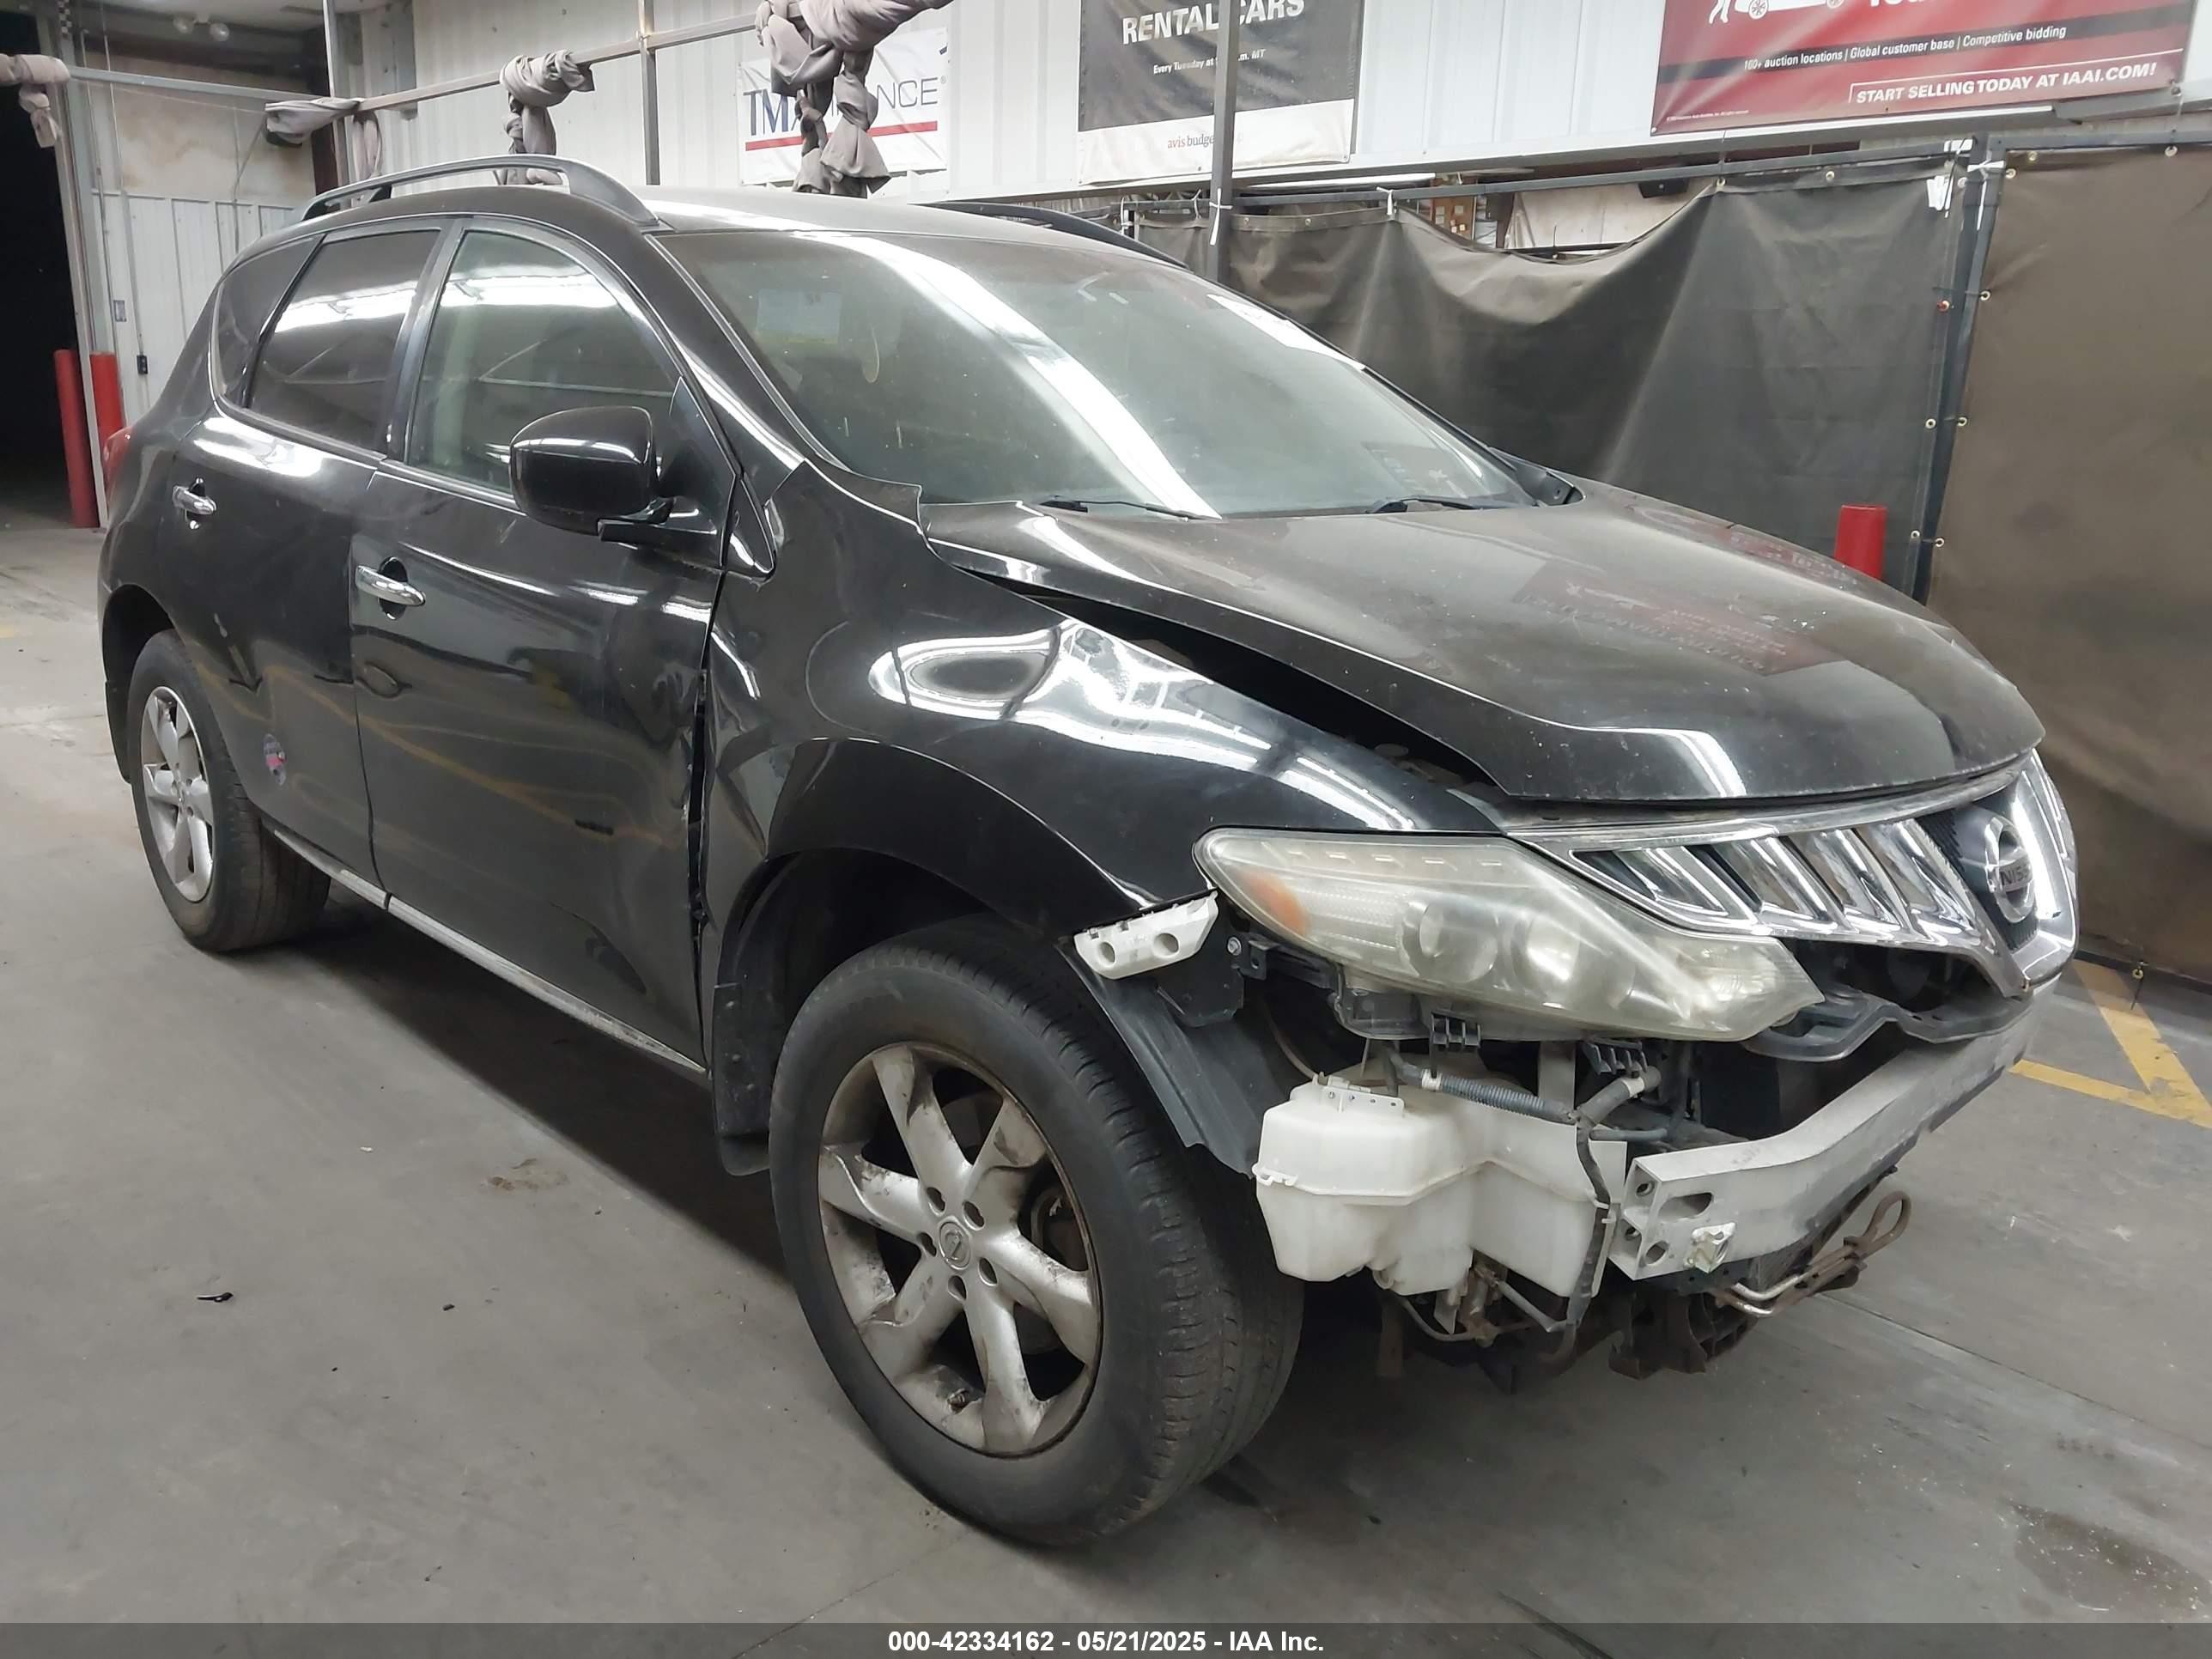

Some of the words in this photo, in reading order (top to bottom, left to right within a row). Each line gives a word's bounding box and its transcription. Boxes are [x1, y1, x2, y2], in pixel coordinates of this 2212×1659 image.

[1122, 3, 1219, 44] RENTAL
[1764, 53, 1798, 69] auction
[1801, 50, 1843, 65] locations
[1850, 44, 1881, 59] Global
[1881, 40, 1929, 56] customer
[1930, 38, 1955, 52] base
[1963, 29, 2023, 47] Competitive
[2026, 25, 2067, 40] bidding
[1153, 61, 1172, 75] Every
[1856, 88, 1905, 103] START
[1908, 80, 1974, 99] SELLING
[1977, 75, 2033, 93] TODAY
[2036, 73, 2060, 88] AT
[2063, 62, 2158, 86] IAAI.COM!
